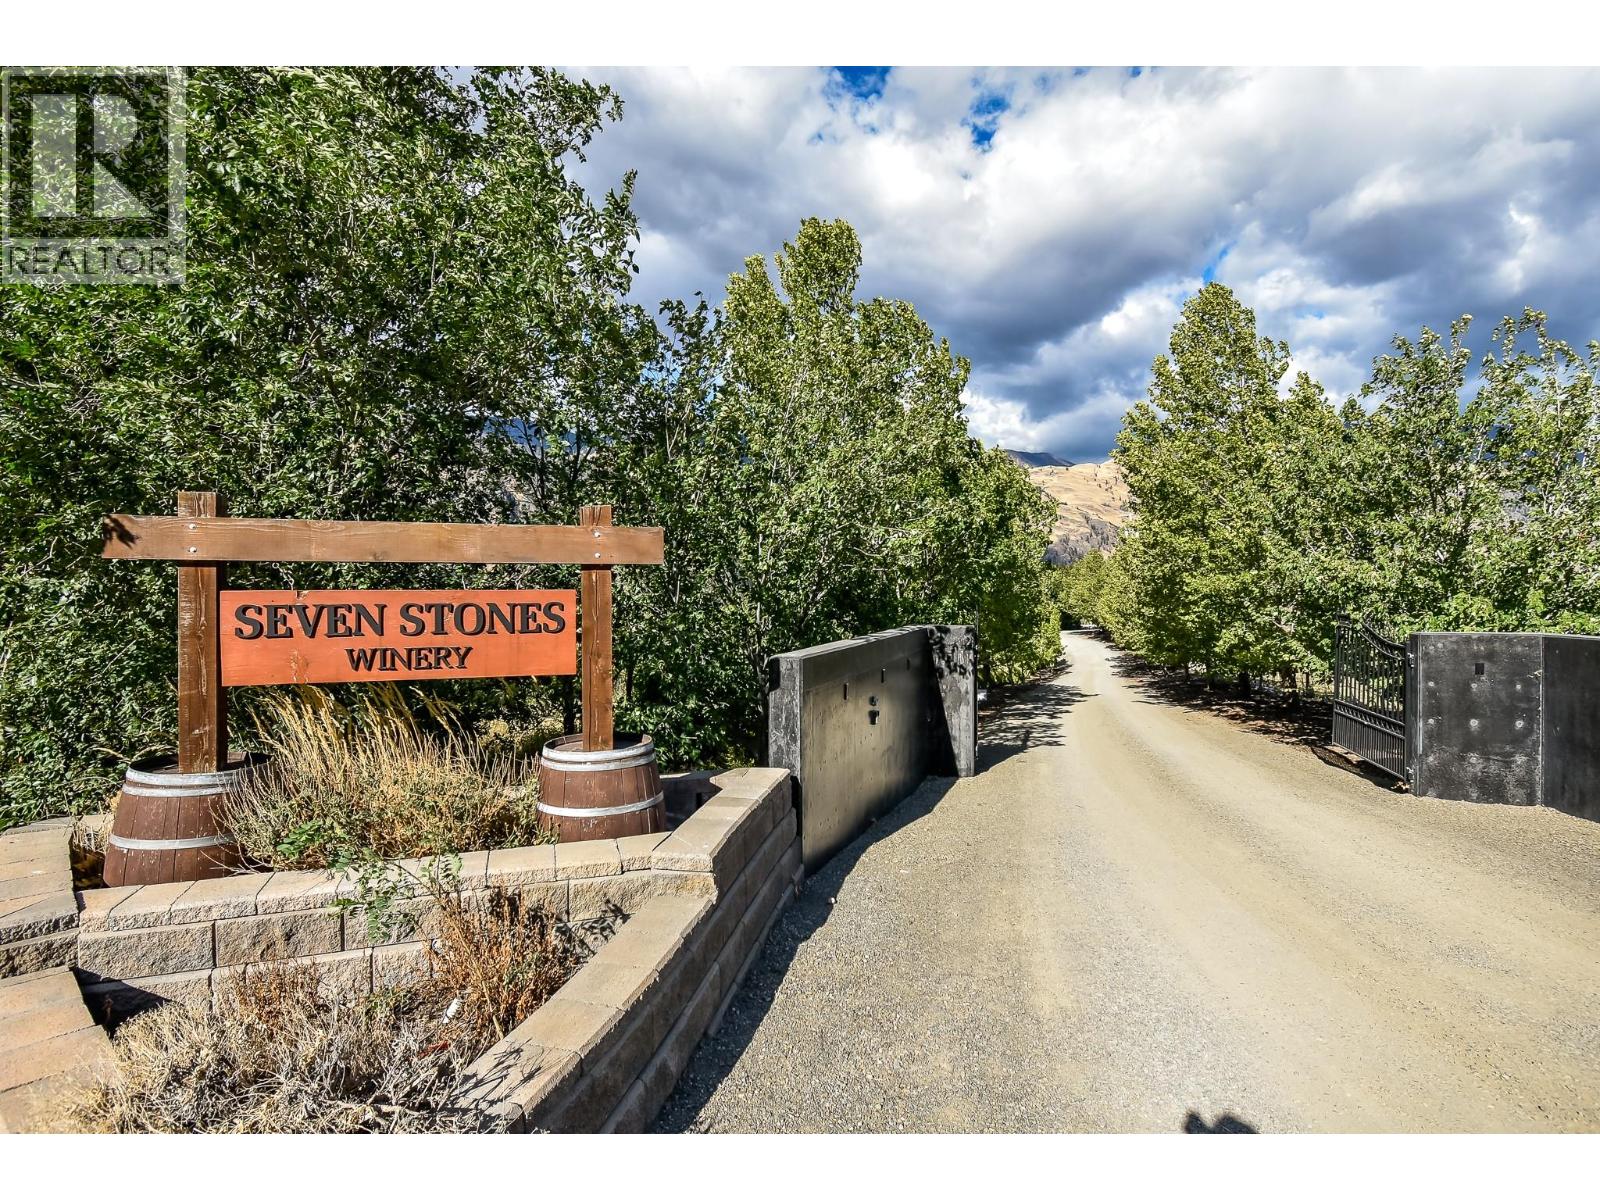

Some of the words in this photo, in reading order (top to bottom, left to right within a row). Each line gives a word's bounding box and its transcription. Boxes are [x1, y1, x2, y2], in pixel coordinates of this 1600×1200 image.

[234, 603, 387, 639] SEVEN
[399, 601, 566, 636] STONES
[346, 646, 474, 671] WINERY
